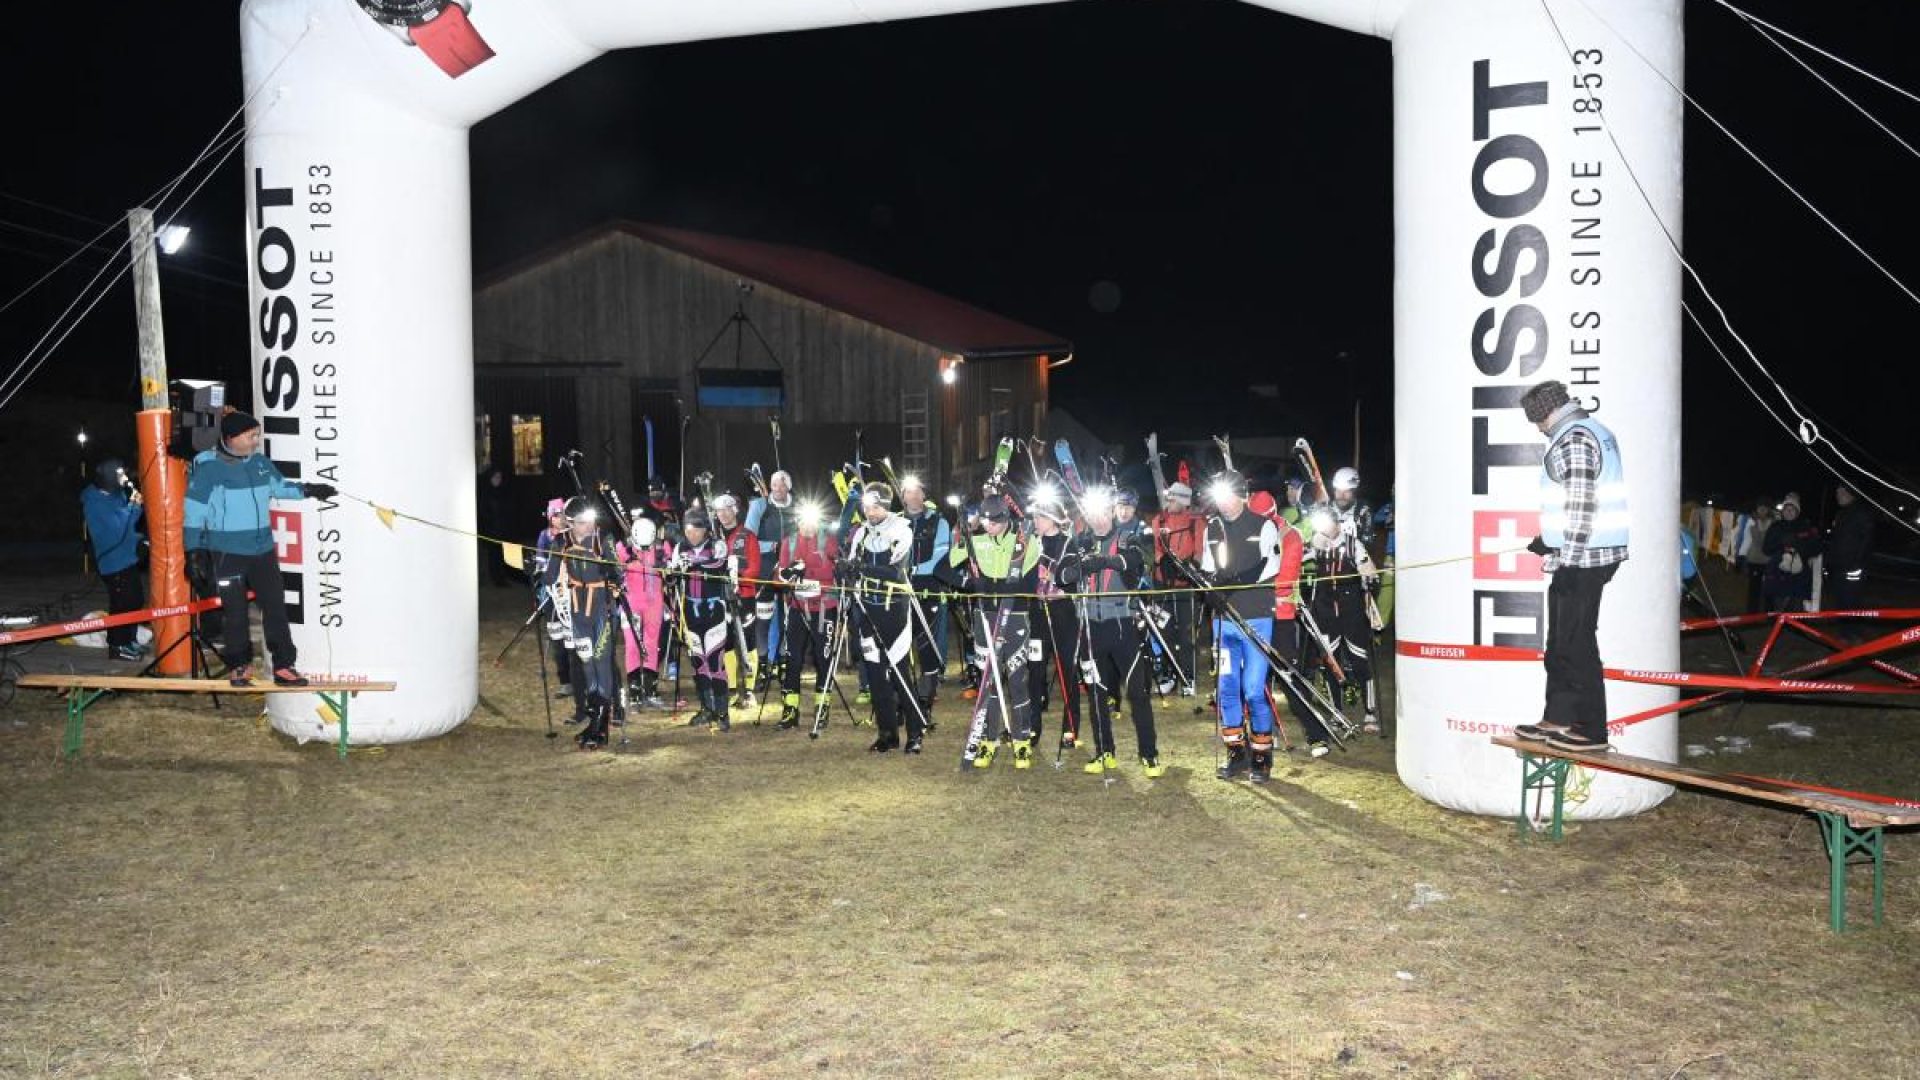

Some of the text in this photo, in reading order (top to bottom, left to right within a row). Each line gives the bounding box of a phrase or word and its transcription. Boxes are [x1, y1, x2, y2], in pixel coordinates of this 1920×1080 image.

[1573, 49, 1603, 136] 1853
[308, 165, 332, 231] 1853
[1571, 162, 1602, 285] SINCE
[310, 250, 335, 345] SINCE
[1472, 59, 1549, 494] TISSOT
[318, 529, 343, 627] SWISS
[1420, 646, 1465, 657] RAIFFEISEN
